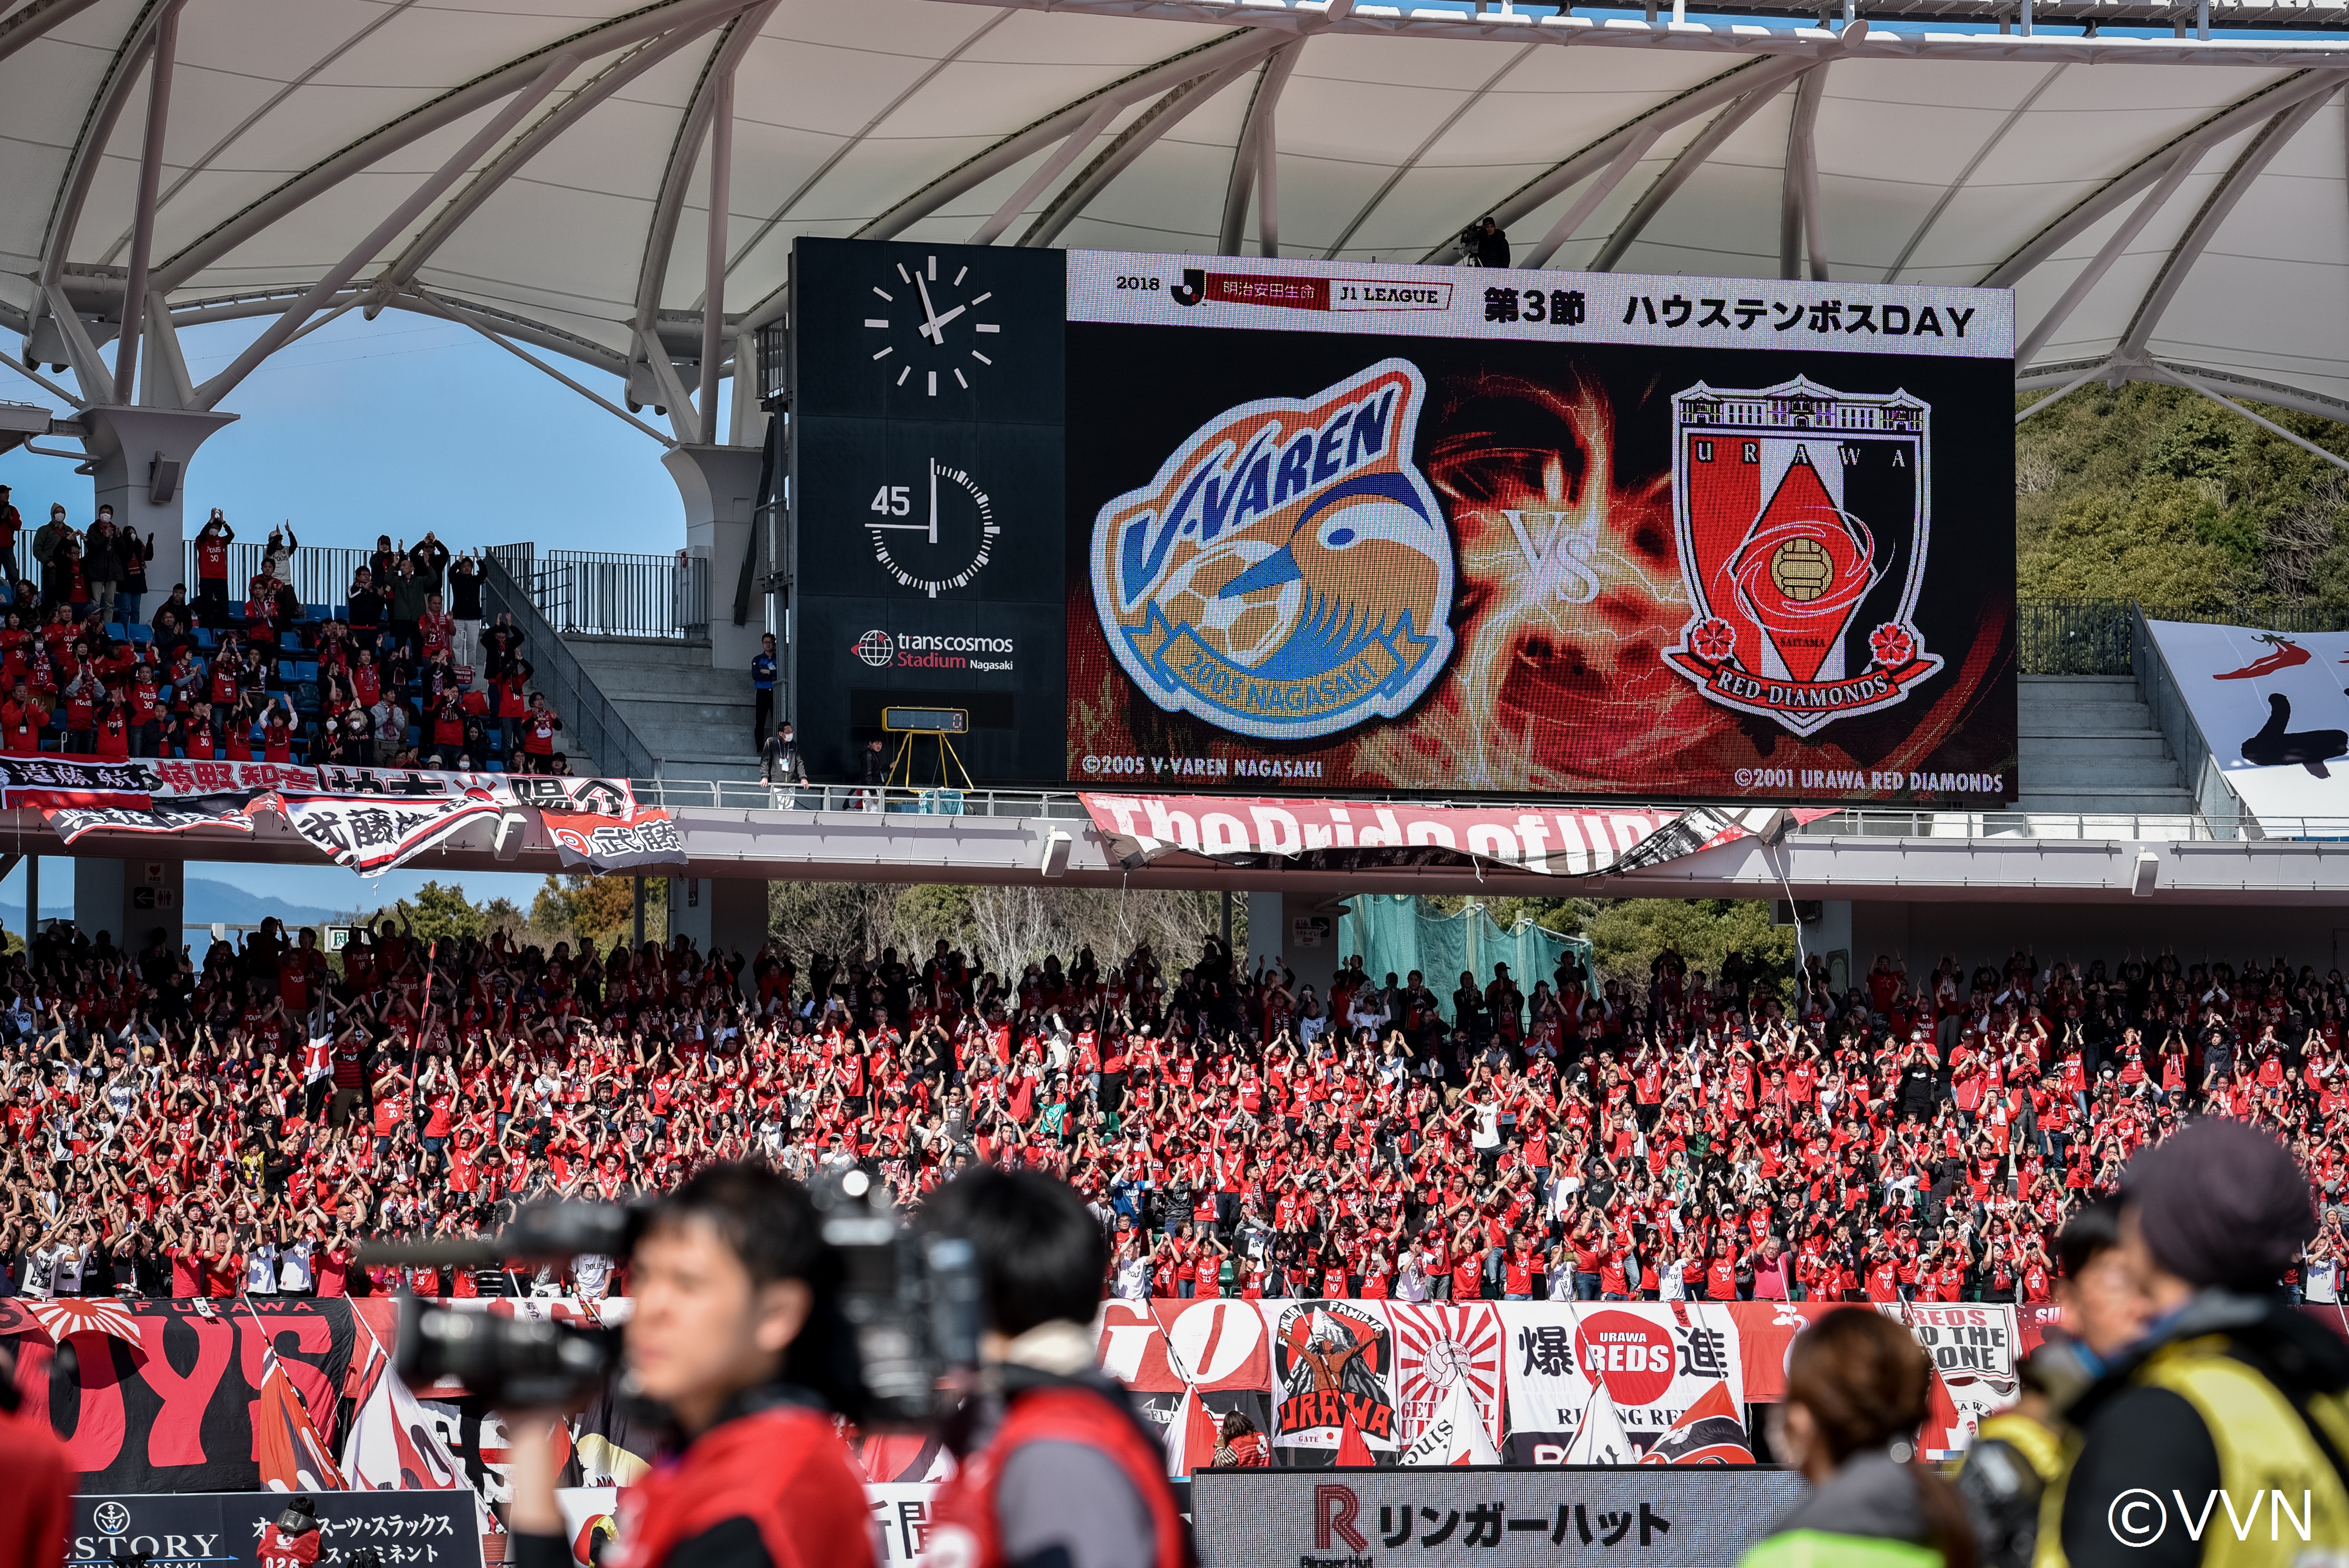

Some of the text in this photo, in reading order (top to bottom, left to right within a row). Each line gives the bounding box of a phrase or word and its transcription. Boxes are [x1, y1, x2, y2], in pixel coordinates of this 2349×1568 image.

[1116, 275, 1160, 290] 2018
[1223, 281, 1315, 300] 明治安田生命
[1340, 287, 1438, 304] J1 LEAGUE
[1484, 287, 1975, 338] 第3節 ハウステンボスDAY
[1695, 440, 1906, 467] URAWA
[871, 486, 910, 516] 45
[1500, 509, 1599, 604] VS
[1780, 636, 1826, 647] SAITAMA
[897, 652, 1013, 671] Stadium Nagasaki
[1182, 651, 1378, 711] 2005 NAGASAKI
[1718, 672, 1890, 706] RED DIAMONDS
[200, 738, 210, 746] 30
[1234, 759, 1322, 779] NAGASAKI
[1734, 768, 2004, 793] ©2001 URAWA RED DIAMONDS
[593, 819, 684, 857] 武藤
[1176, 1065, 1193, 1074] POLUS
[1180, 1074, 1188, 1082] 22
[1654, 1210, 1669, 1218] POLUS
[1752, 1220, 1767, 1228] POLUS
[1199, 1267, 1216, 1276] POLUS
[1717, 1266, 1732, 1274] POLUS
[418, 1276, 425, 1285] 15
[1161, 1275, 1169, 1284] 30
[1325, 1275, 1342, 1283] POLUS
[1365, 1279, 1374, 1287] 30
[1674, 1281, 1678, 1289] 6
[1883, 1280, 1890, 1289] 10
[2031, 1280, 2040, 1288] 30
[1330, 1284, 1338, 1292] 10
[1599, 1331, 1647, 1343] URAWA
[1951, 1327, 2006, 1348] THE
[1519, 1325, 1573, 1377] 爆
[1585, 1344, 1670, 1372] REDS
[1675, 1325, 1728, 1378] 進
[1279, 1389, 1392, 1437] URAWA
[1557, 1408, 1647, 1425] RING
[1379, 1501, 1672, 1549] リンガーハット
